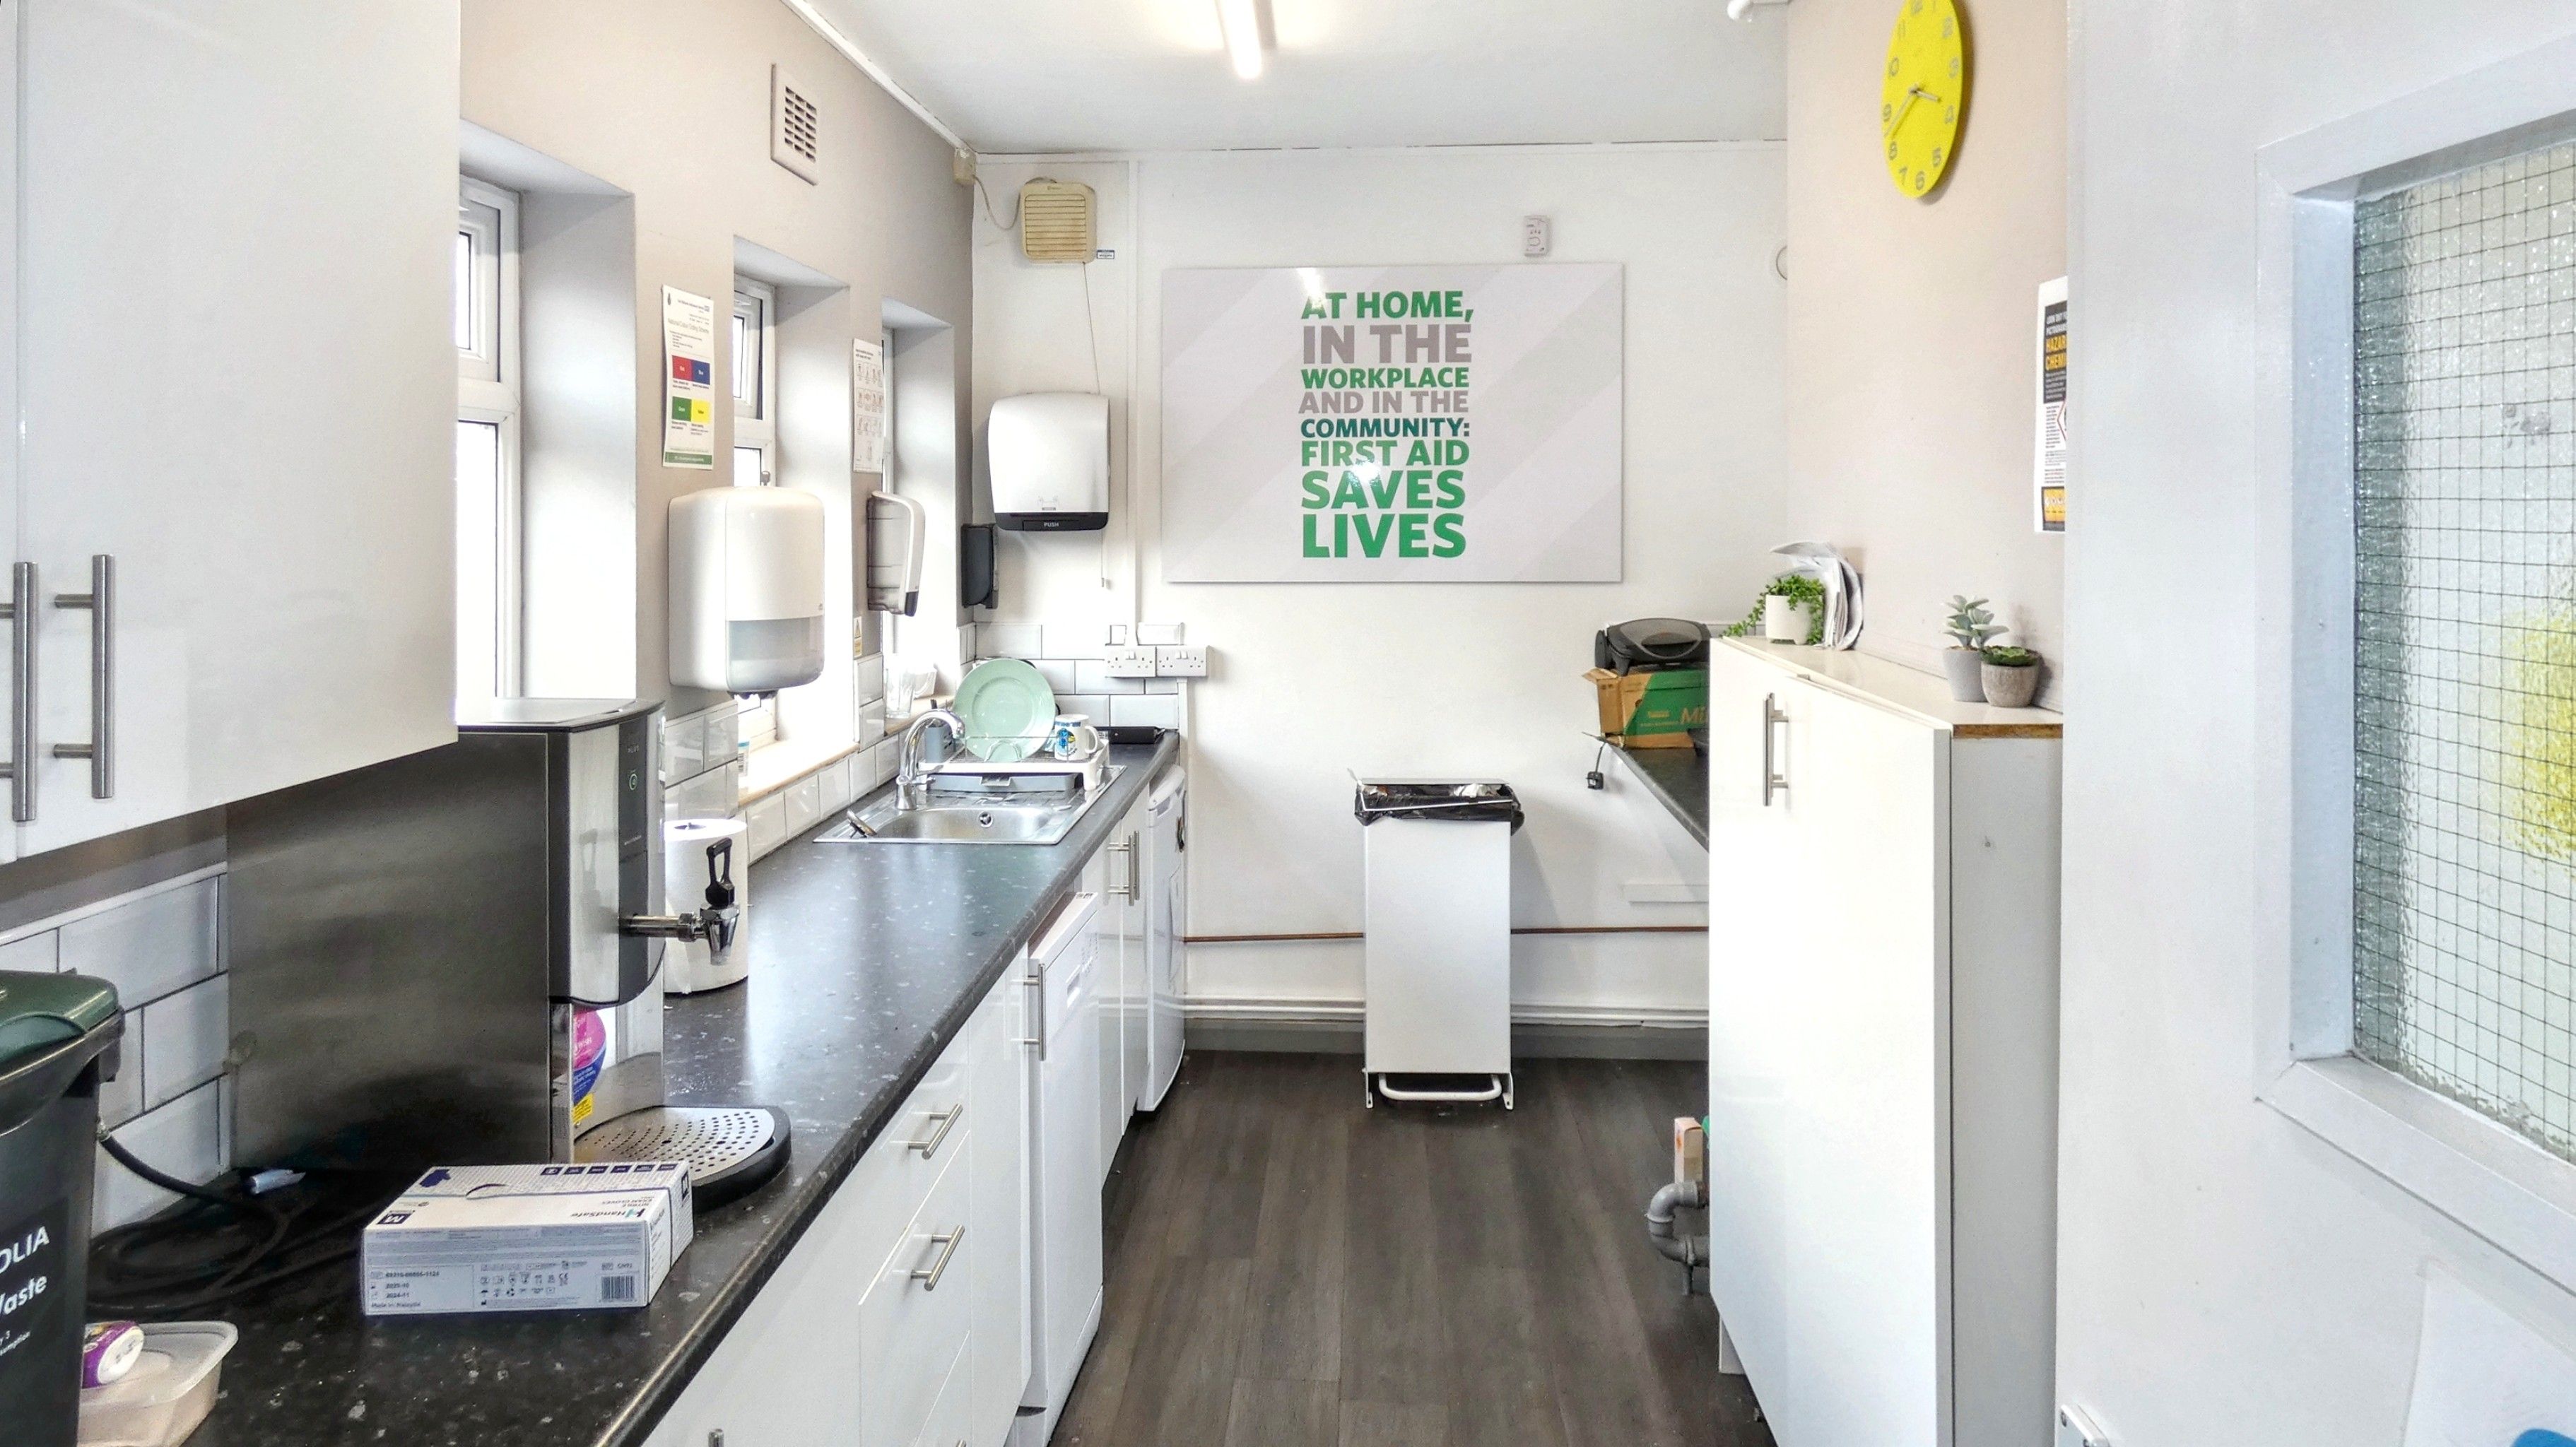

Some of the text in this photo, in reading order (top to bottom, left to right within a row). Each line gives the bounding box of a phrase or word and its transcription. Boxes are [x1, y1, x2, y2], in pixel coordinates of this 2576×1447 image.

[1301, 290, 1474, 322] AT HOME,
[1303, 324, 1472, 364] IN THE
[1301, 367, 1470, 389] WORKPLACE
[1299, 391, 1469, 414] AND IN THE
[1301, 418, 1470, 438] COMMUNITY:
[1302, 439, 1470, 466] FIRST AID
[1302, 470, 1466, 509] SAVES
[1302, 513, 1466, 558] LIVES
[384, 1215, 406, 1224] M
[570, 1210, 625, 1218] HandSafe
